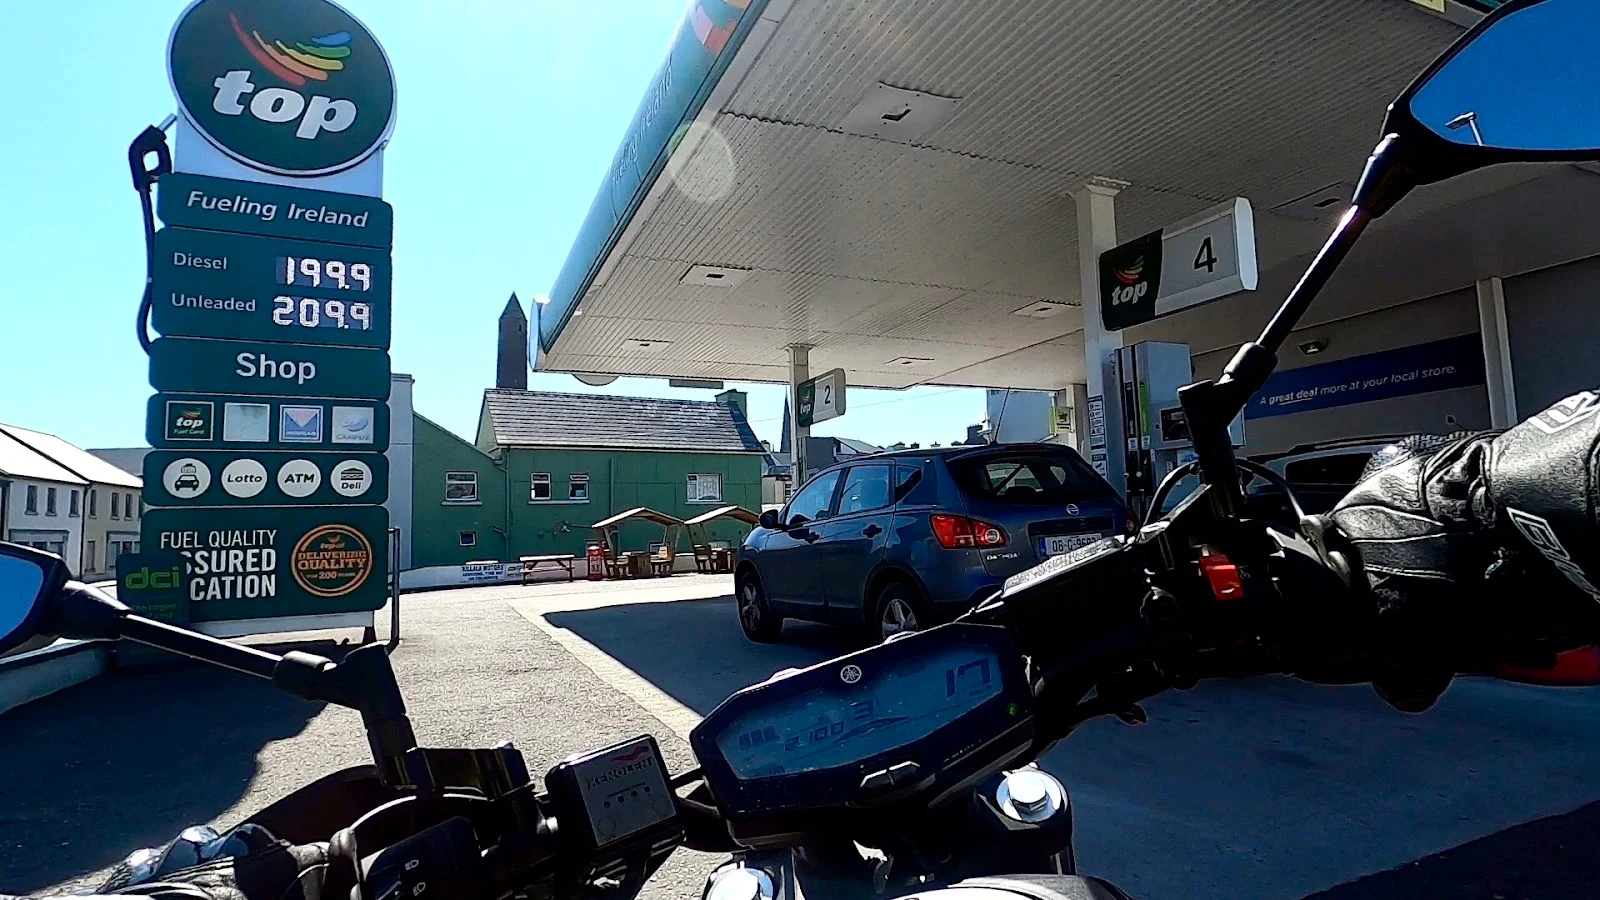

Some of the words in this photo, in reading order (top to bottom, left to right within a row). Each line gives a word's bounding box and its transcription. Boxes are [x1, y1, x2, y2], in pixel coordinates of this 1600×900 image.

[211, 70, 357, 140] top
[187, 190, 278, 221] Fueling
[287, 202, 369, 229] Ireland
[1193, 236, 1218, 274] 4
[173, 252, 227, 270] Diesel
[286, 256, 371, 292] 199.9
[1111, 280, 1148, 306] top
[171, 292, 256, 312] Unleaded
[273, 296, 371, 331] 209.9
[236, 352, 316, 384] Shop
[824, 386, 831, 405] 2
[1260, 396, 1268, 405] A
[1268, 391, 1294, 405] great
[1296, 387, 1318, 399] deal
[1320, 384, 1348, 395] more
[1349, 380, 1360, 391] at
[1362, 377, 1389, 391] your
[1390, 371, 1420, 384] local
[176, 416, 204, 429] top
[227, 474, 263, 484] Lotto
[284, 473, 315, 484] ATM
[341, 481, 361, 490] Deli
[160, 531, 203, 549] FUEL
[208, 529, 277, 548] QUALITY
[298, 550, 366, 560] DELIVERING
[298, 559, 366, 570] QUALITY
[125, 566, 180, 590] dci
[190, 574, 276, 601] CATION
